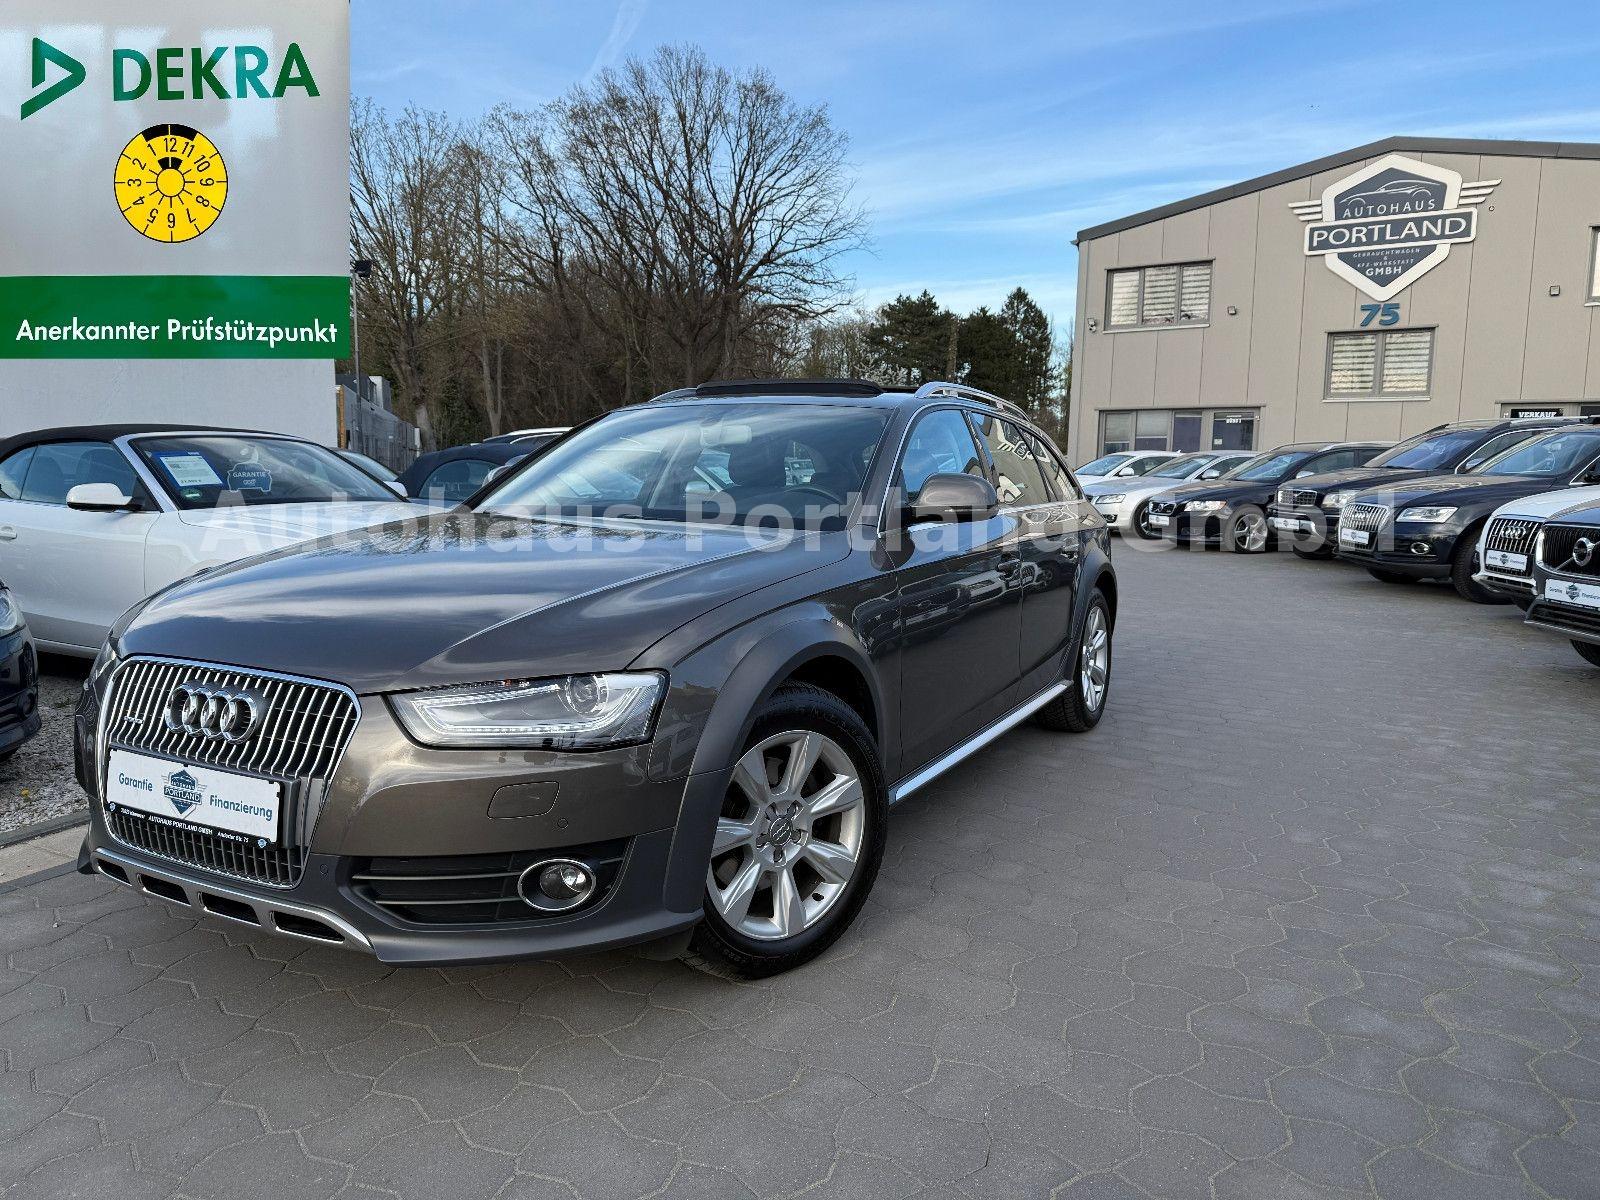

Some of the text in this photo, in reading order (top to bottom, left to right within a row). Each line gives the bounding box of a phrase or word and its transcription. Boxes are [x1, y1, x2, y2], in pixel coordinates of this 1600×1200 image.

[112, 42, 320, 101] DEKRA
[146, 143, 156, 156] 1
[163, 137, 178, 153] 12
[182, 142, 195, 157] 11
[132, 158, 147, 170] 2
[194, 154, 211, 173] 10
[127, 178, 142, 187] 3
[199, 177, 215, 187] 9
[132, 195, 145, 206] 4
[195, 195, 210, 207] 8
[1343, 199, 1435, 218] AUTOHAUS
[147, 208, 158, 222] 5
[167, 213, 176, 229] 6
[185, 207, 197, 224] 7
[1312, 217, 1467, 247] PORTLAND
[1365, 266, 1402, 276] GMBH
[1360, 303, 1400, 327] 75
[15, 317, 338, 348] Anerkannter Prüfstützpunkt
[118, 772, 153, 792] Garantie
[165, 786, 200, 802] PORTLAND
[209, 795, 273, 822] Finanzierung
